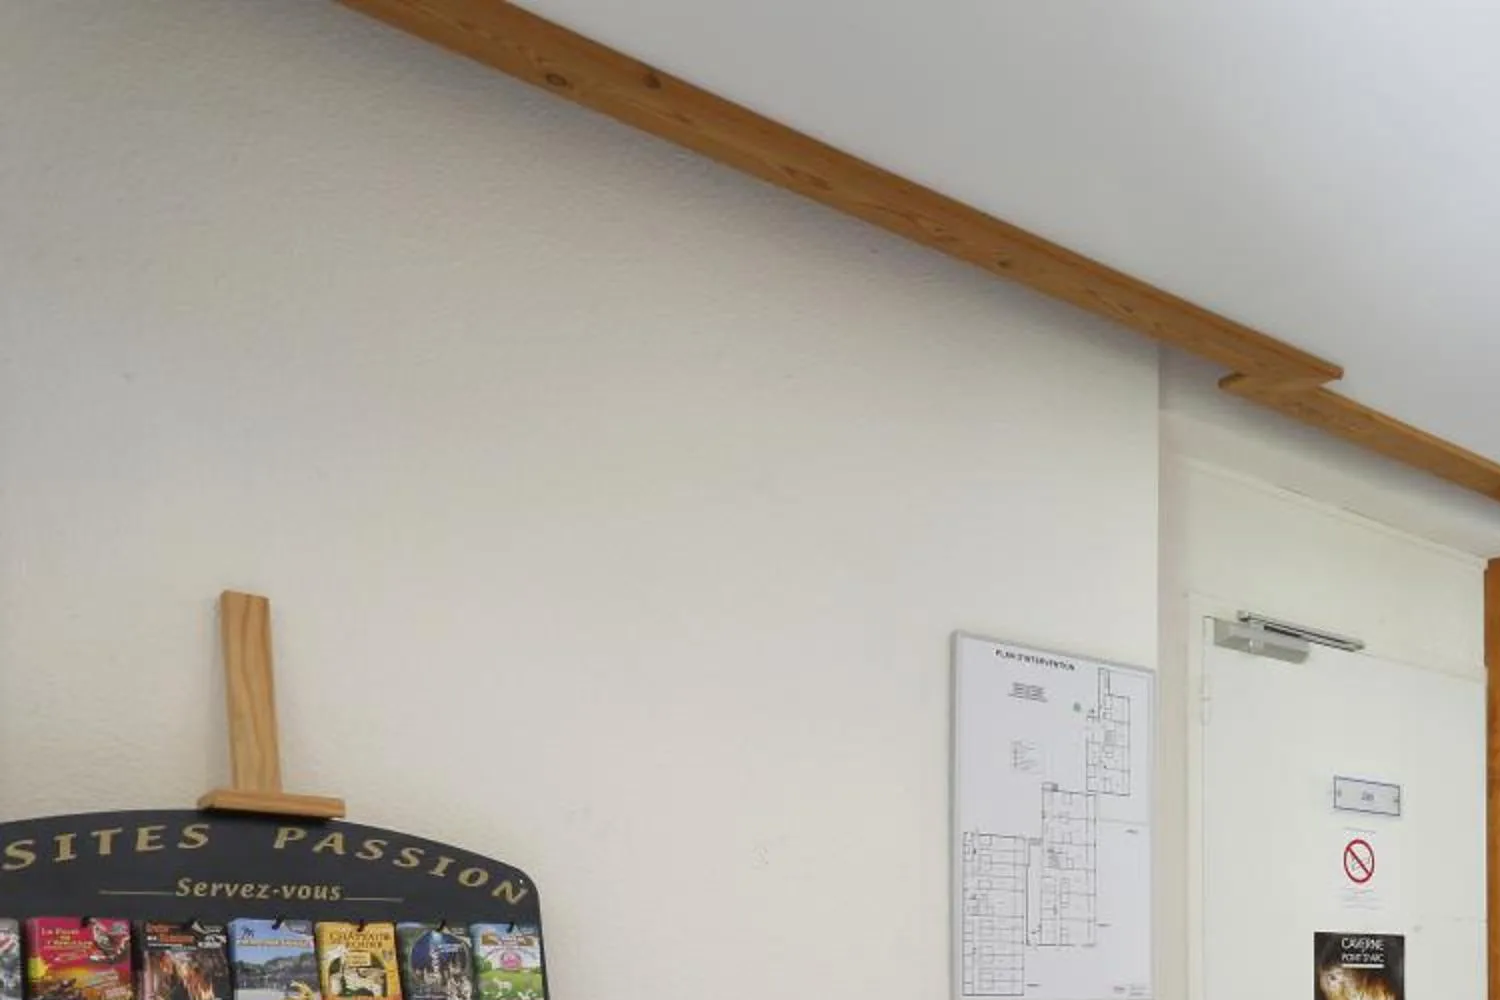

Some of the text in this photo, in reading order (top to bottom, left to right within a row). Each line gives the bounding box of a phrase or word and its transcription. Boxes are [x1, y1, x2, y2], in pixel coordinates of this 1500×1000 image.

[2, 823, 531, 906] SITES PASSION
[175, 877, 342, 902] Servez-vous
[1341, 937, 1384, 950] CAVERNE
